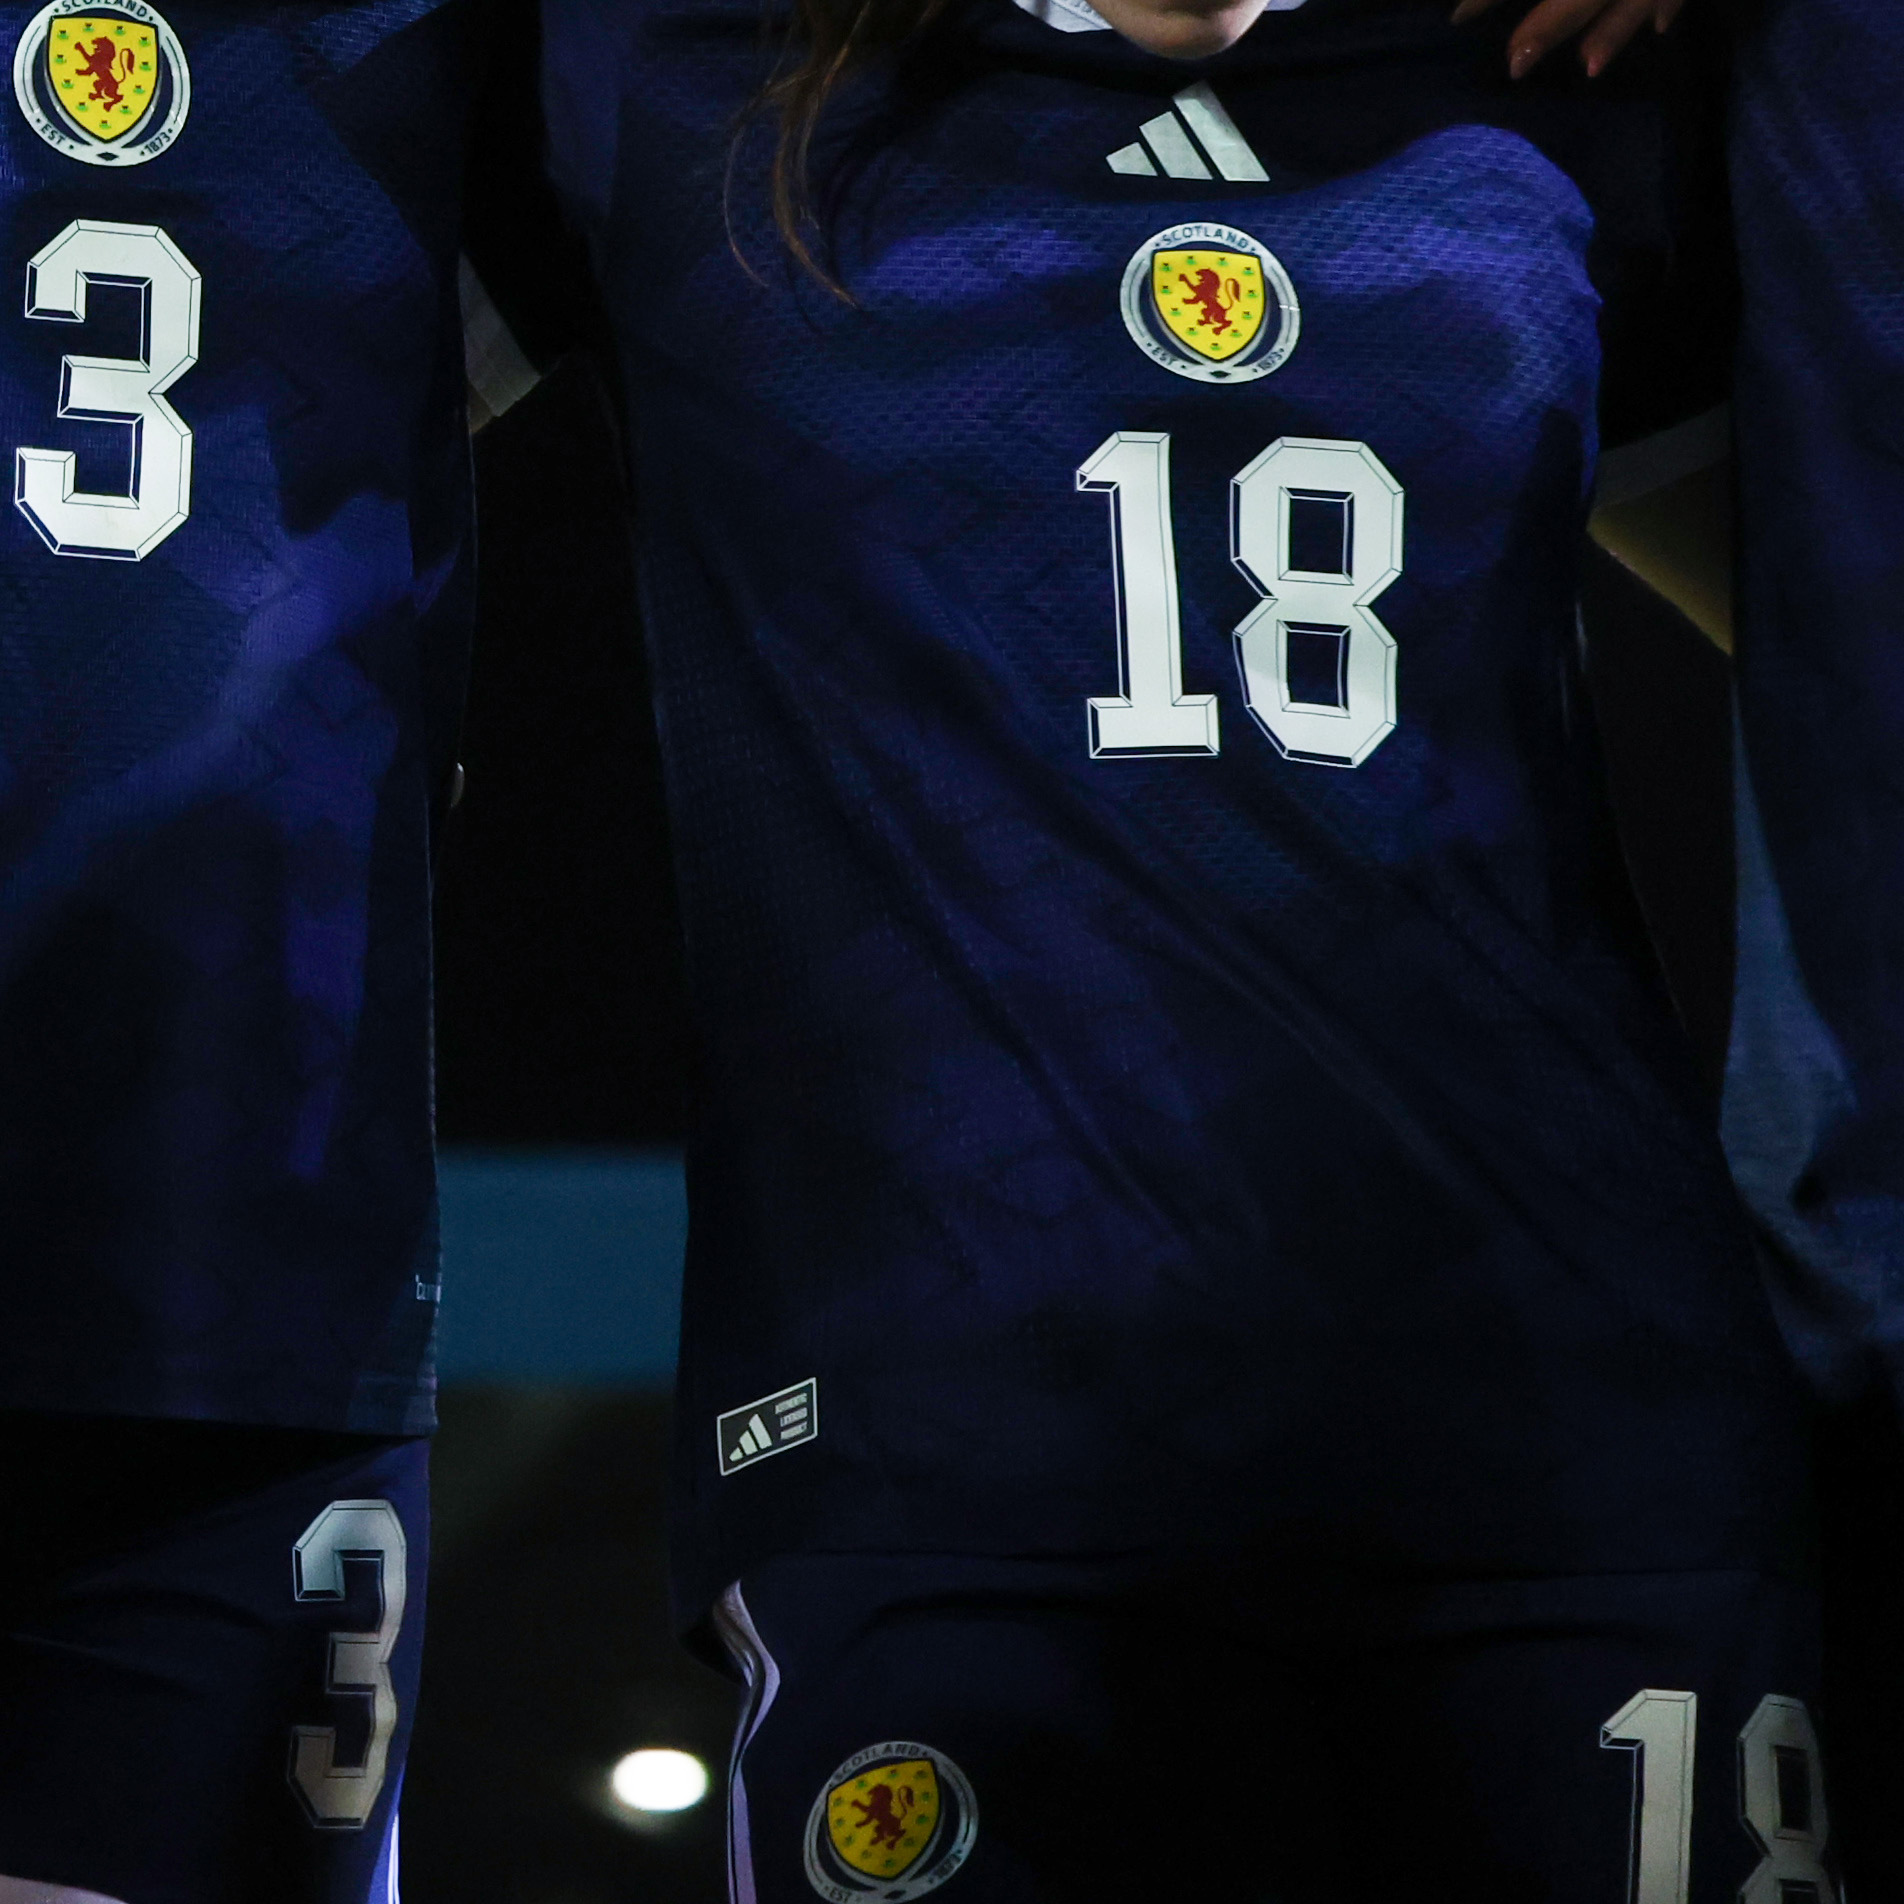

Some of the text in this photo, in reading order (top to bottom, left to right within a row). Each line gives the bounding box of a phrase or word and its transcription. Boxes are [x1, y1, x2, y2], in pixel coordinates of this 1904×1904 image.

[41, 123, 171, 155] EST 1873
[1161, 224, 1250, 249] SCOTLAND
[13, 217, 203, 563] 3
[1151, 346, 1176, 366] EST
[1074, 430, 1406, 770] 18
[288, 1498, 408, 1830] 3
[1599, 1688, 1848, 1904] 18
